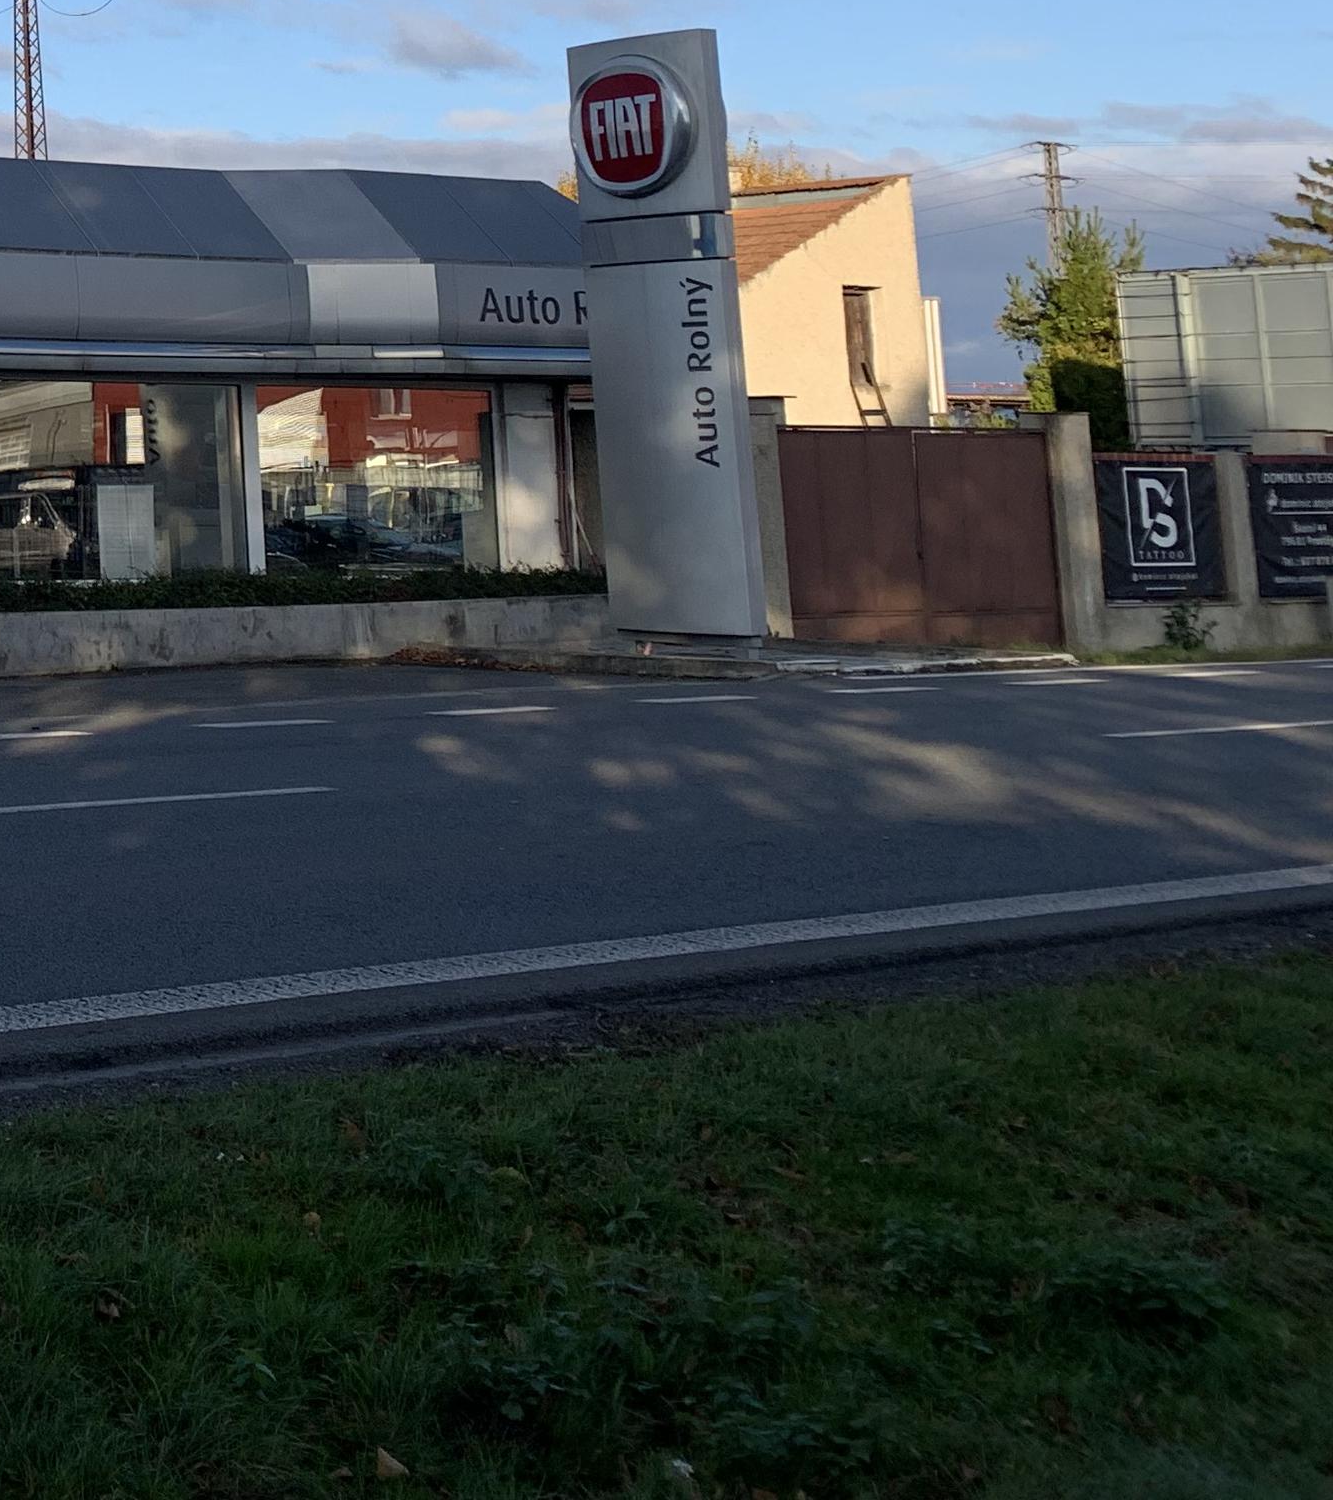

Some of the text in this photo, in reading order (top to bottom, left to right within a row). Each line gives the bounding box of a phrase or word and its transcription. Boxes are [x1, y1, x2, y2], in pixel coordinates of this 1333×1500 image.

[589, 93, 656, 162] FIAT
[480, 287, 561, 325] Auto
[680, 276, 720, 468] Auto Rolný
[1139, 550, 1185, 560] TATTOO
